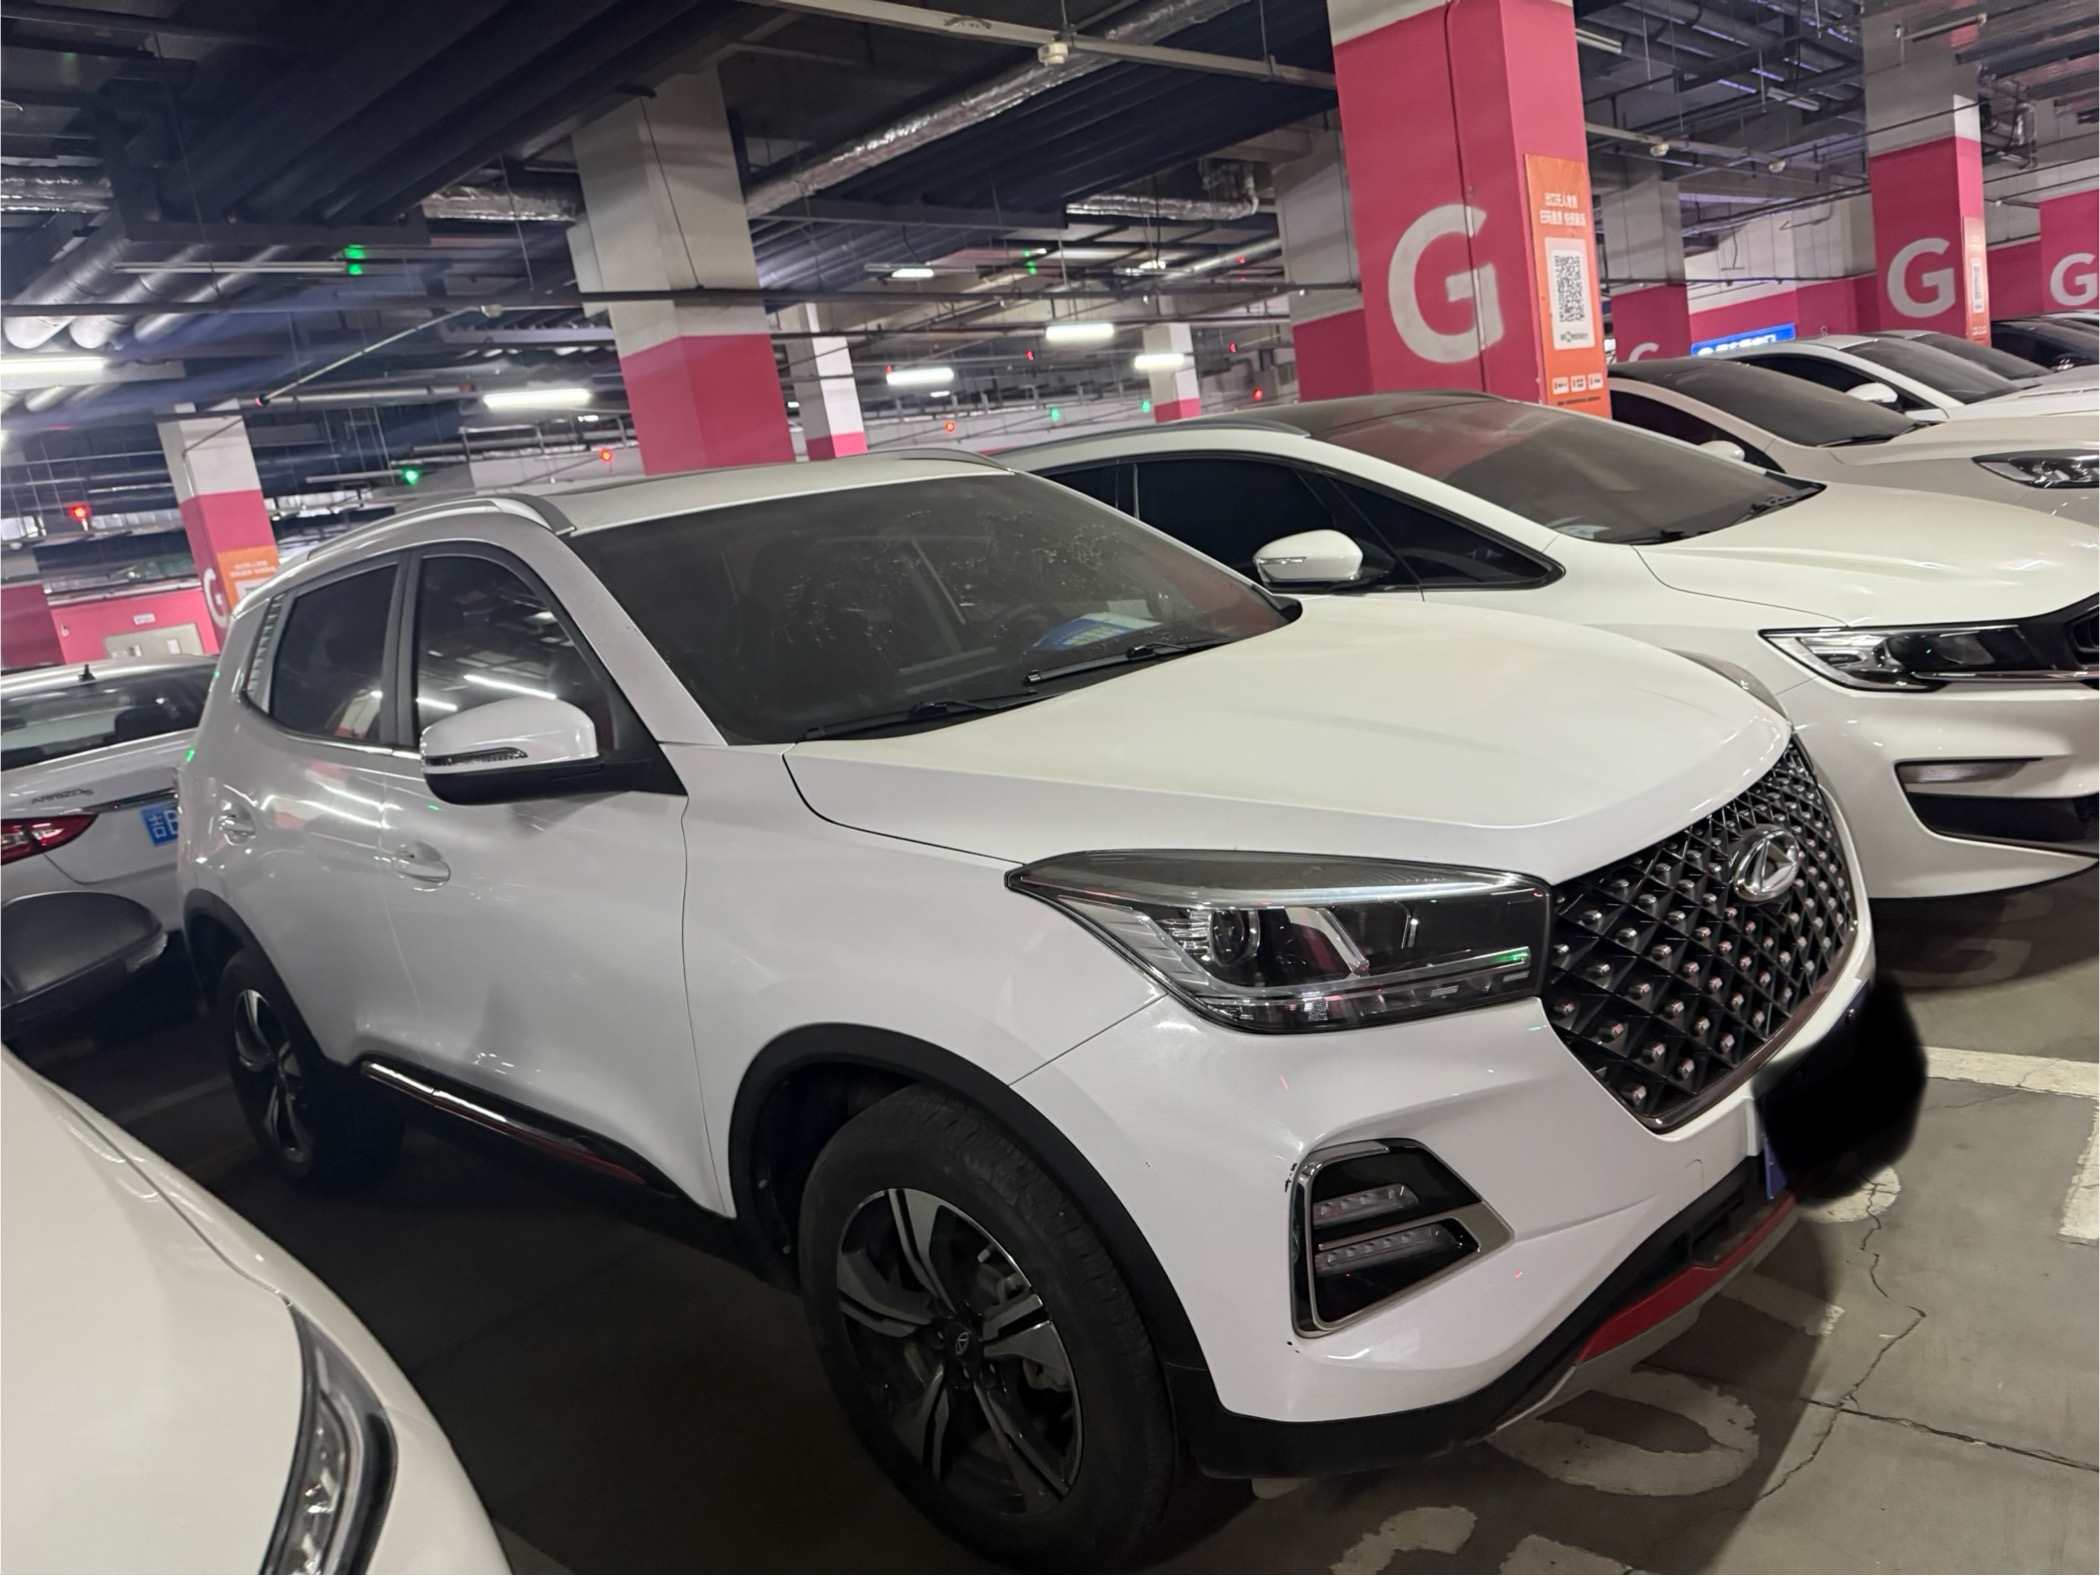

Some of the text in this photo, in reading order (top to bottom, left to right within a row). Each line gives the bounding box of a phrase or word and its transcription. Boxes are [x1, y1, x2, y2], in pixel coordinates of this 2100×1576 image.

[1388, 203, 1504, 363] G
[1887, 237, 1956, 318] G
[2050, 252, 2098, 306] G
